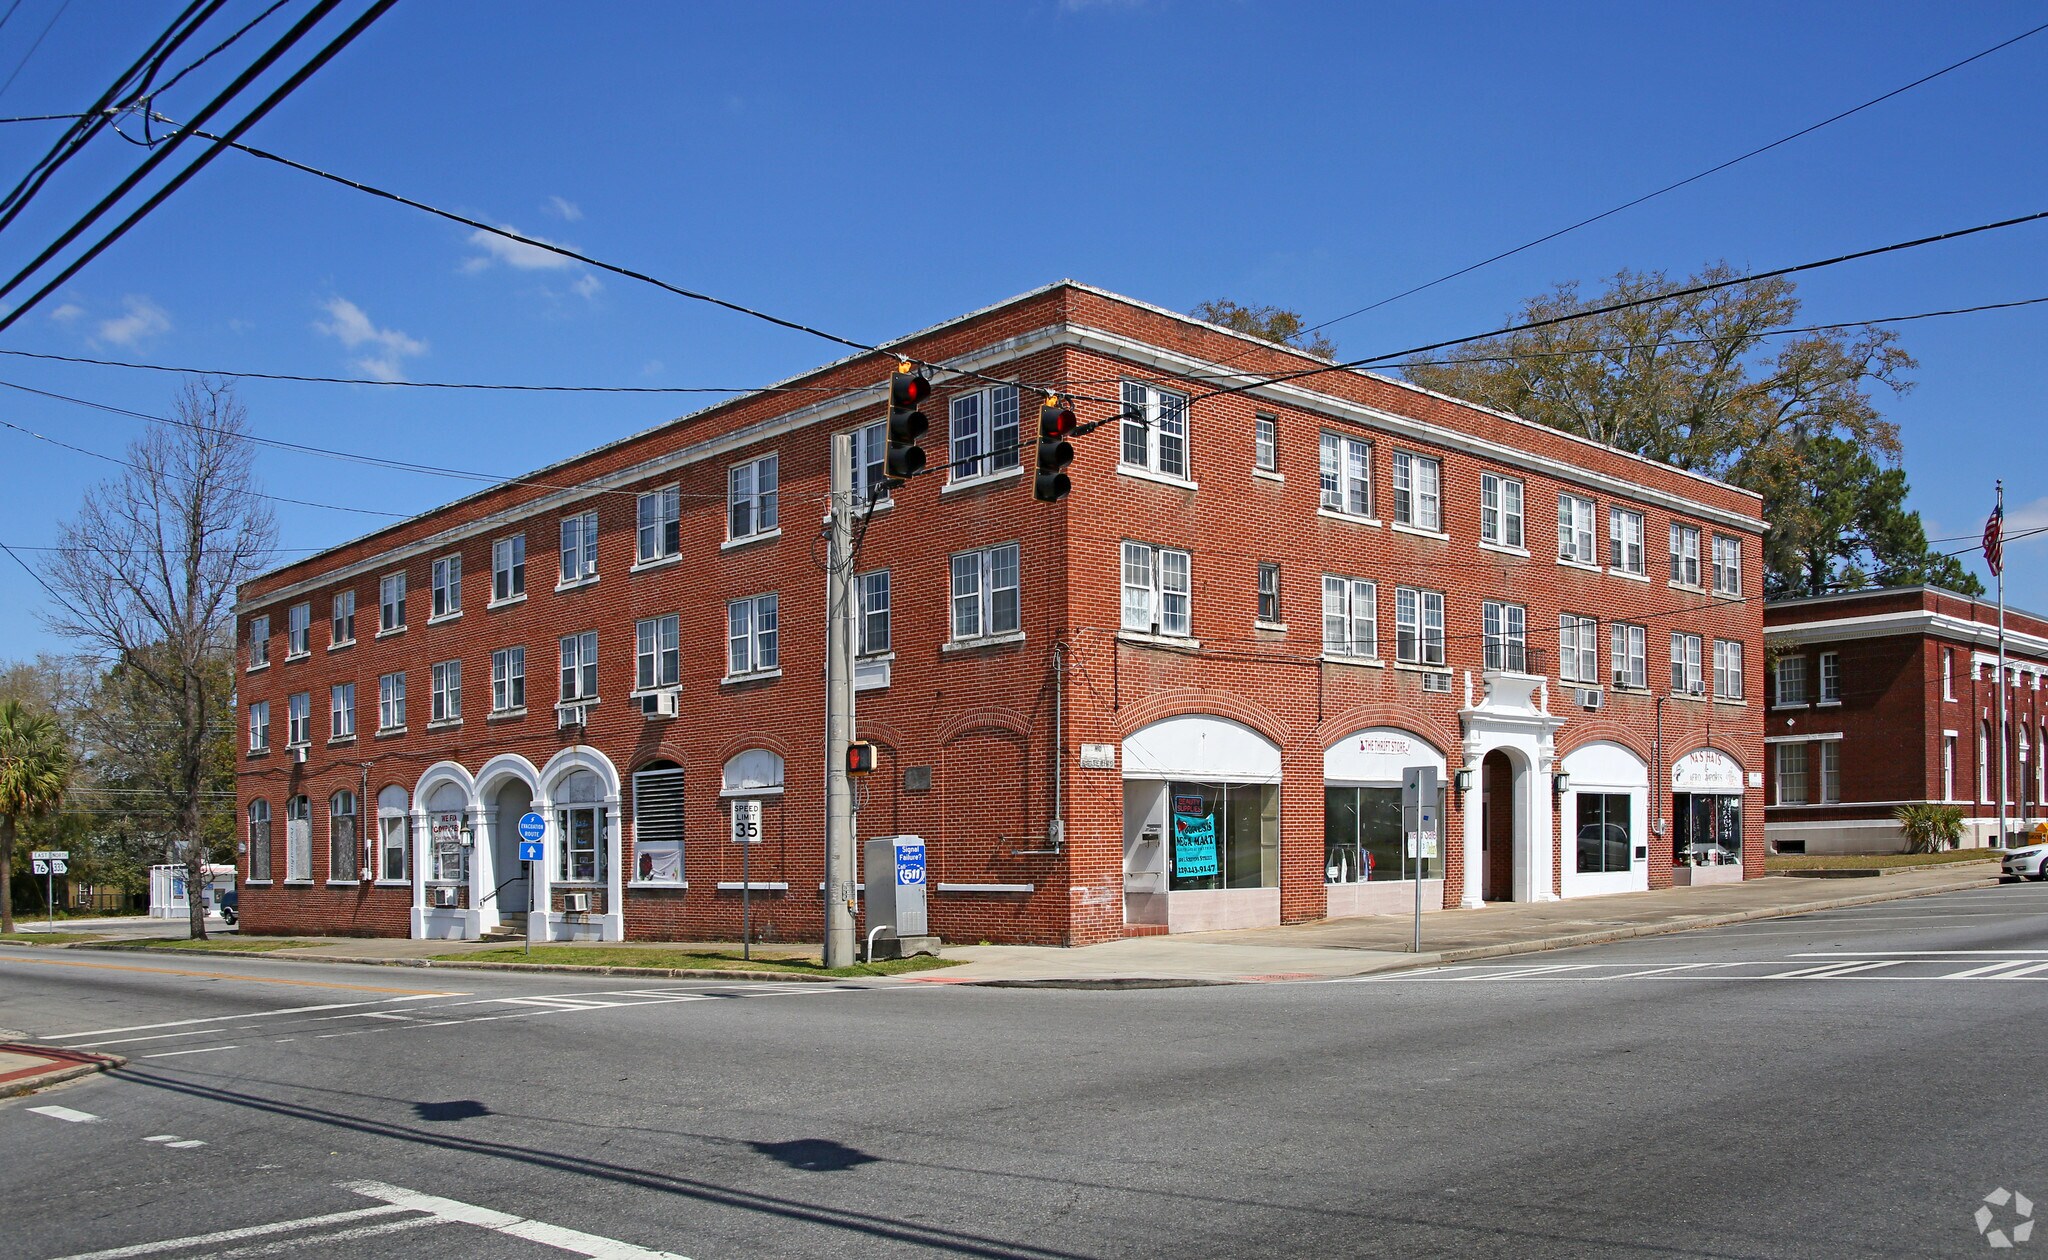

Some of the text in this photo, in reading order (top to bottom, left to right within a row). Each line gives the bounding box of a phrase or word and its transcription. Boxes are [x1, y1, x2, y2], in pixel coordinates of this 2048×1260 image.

[1365, 740, 1374, 751] THE
[1391, 741, 1406, 752] STORE
[1706, 752, 1722, 765] HATS
[1177, 805, 1202, 813] SUPPLIES
[736, 822, 758, 837] 35
[1194, 835, 1214, 846] MART
[902, 846, 919, 854] Signal
[36, 863, 47, 872] 76
[54, 863, 64, 872] 333
[904, 869, 920, 879] 511
